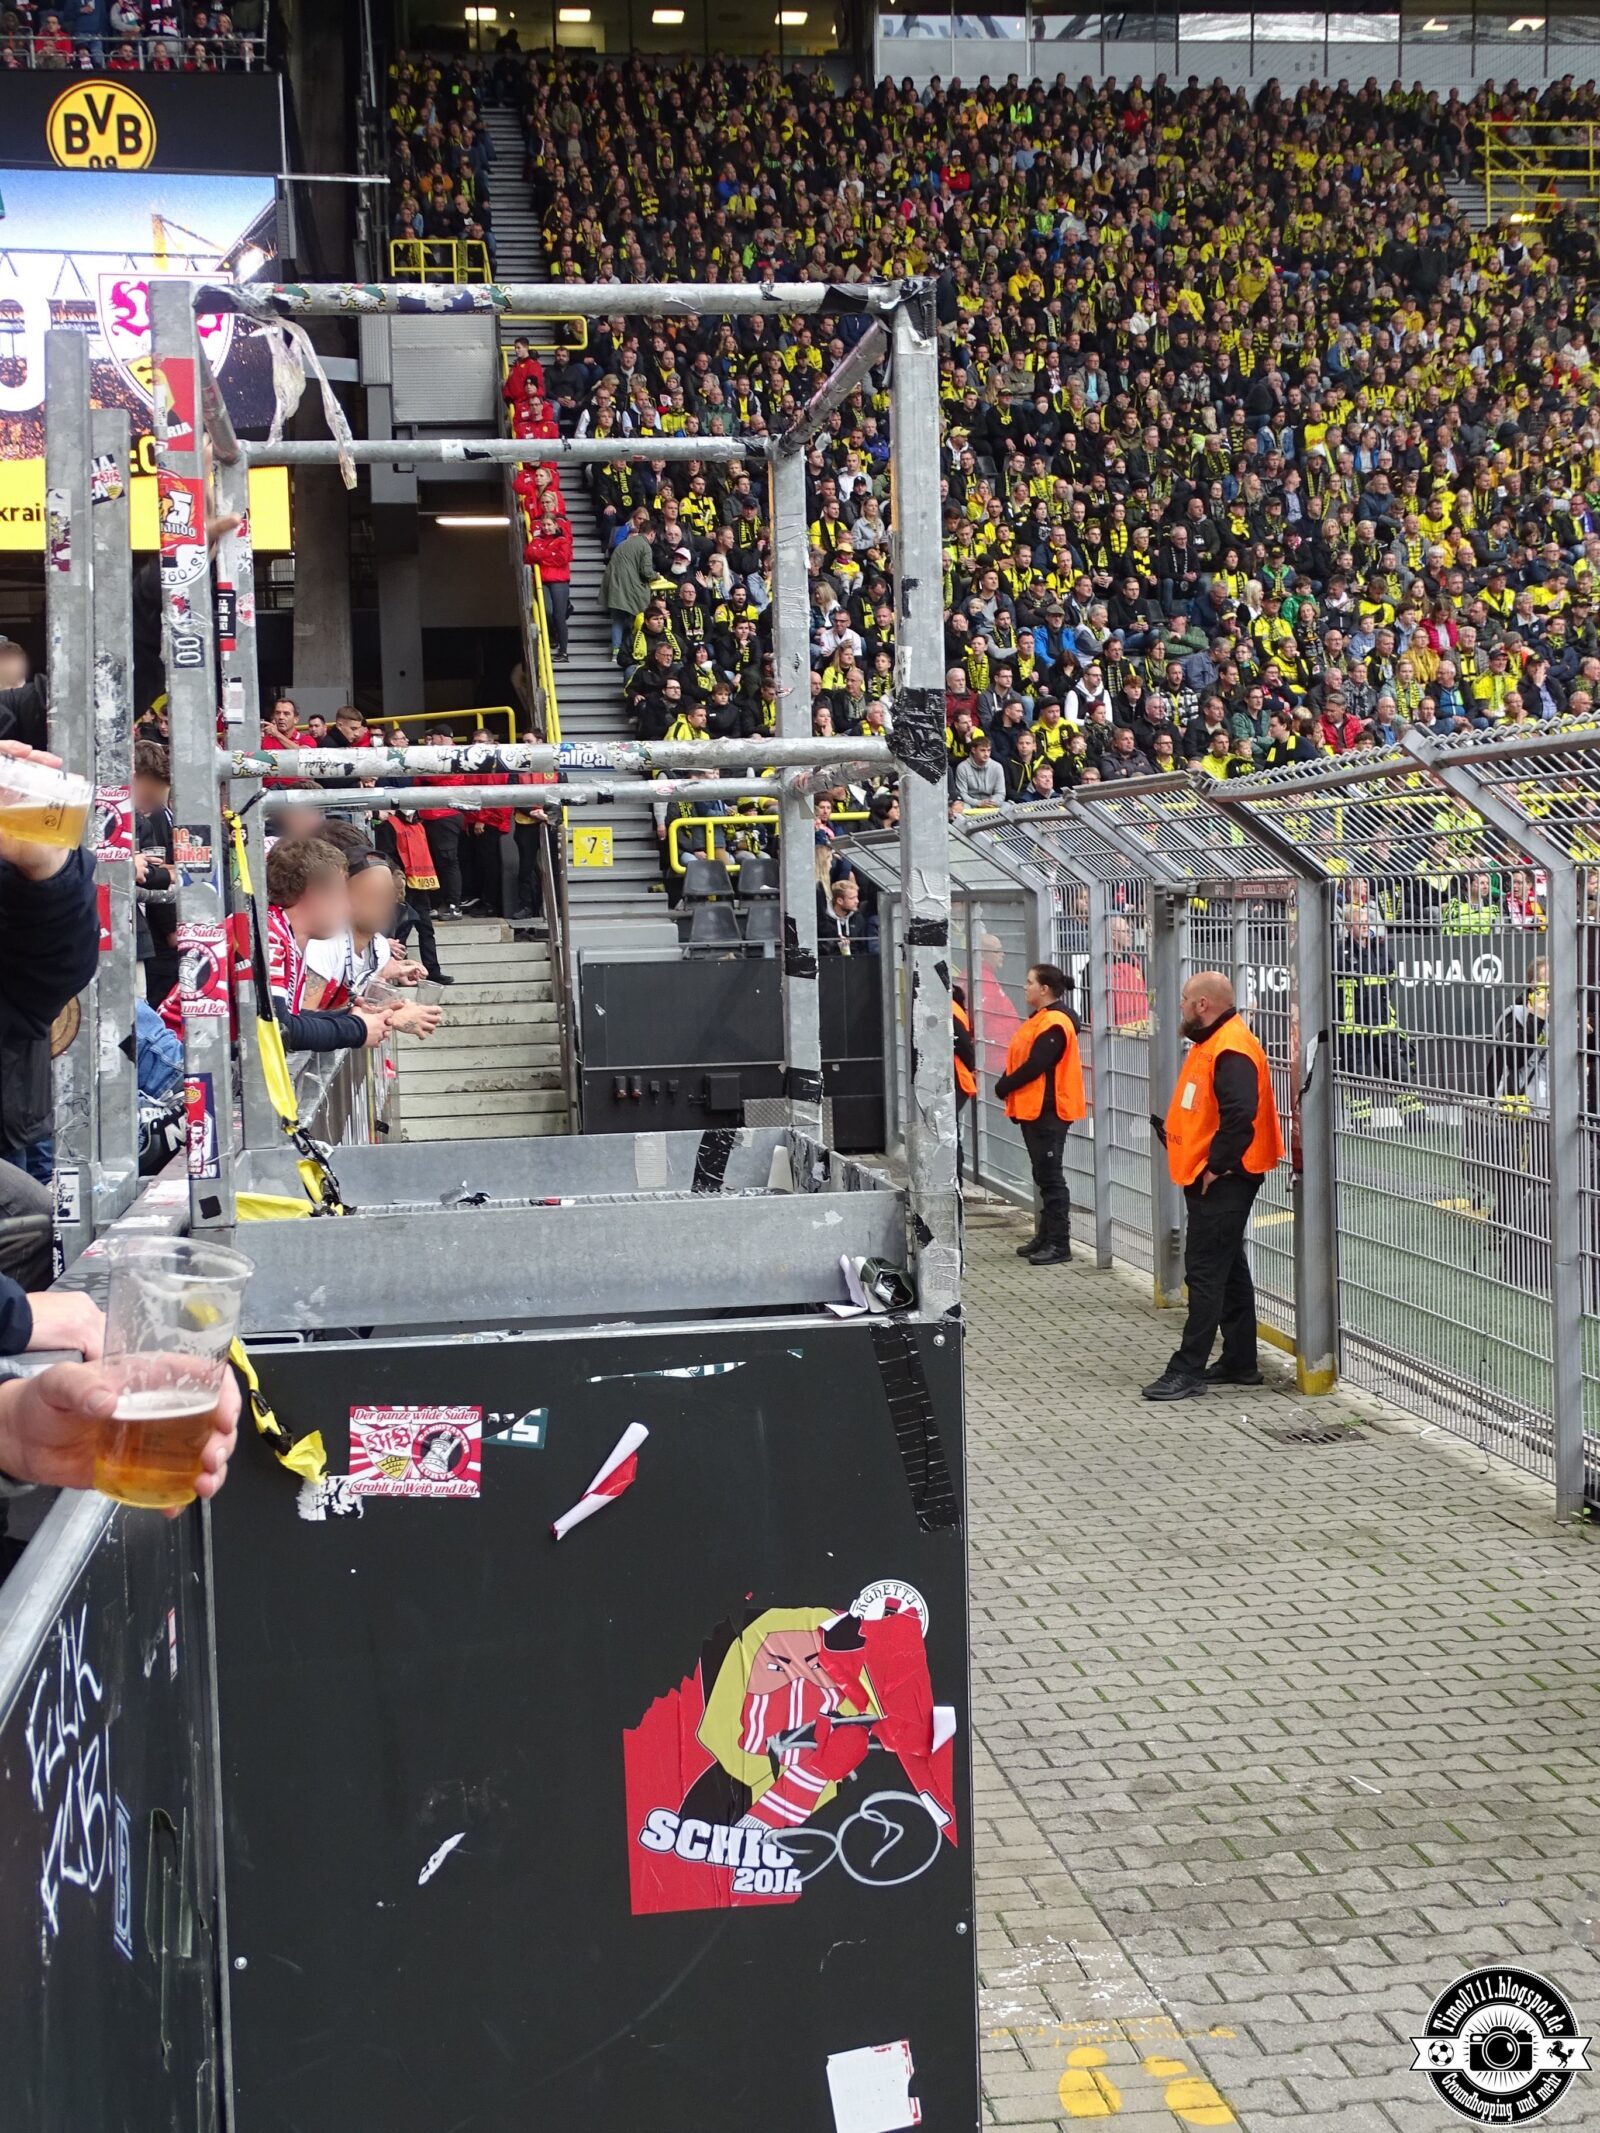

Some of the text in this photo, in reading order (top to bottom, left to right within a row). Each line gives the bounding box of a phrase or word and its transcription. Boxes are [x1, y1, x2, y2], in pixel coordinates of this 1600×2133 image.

[63, 93, 143, 155] BVB
[1398, 960, 1467, 988] UNA
[355, 1407, 478, 1422] Der ganze wilde Süden
[351, 1481, 477, 1495] strahlt in Weiß und Rot
